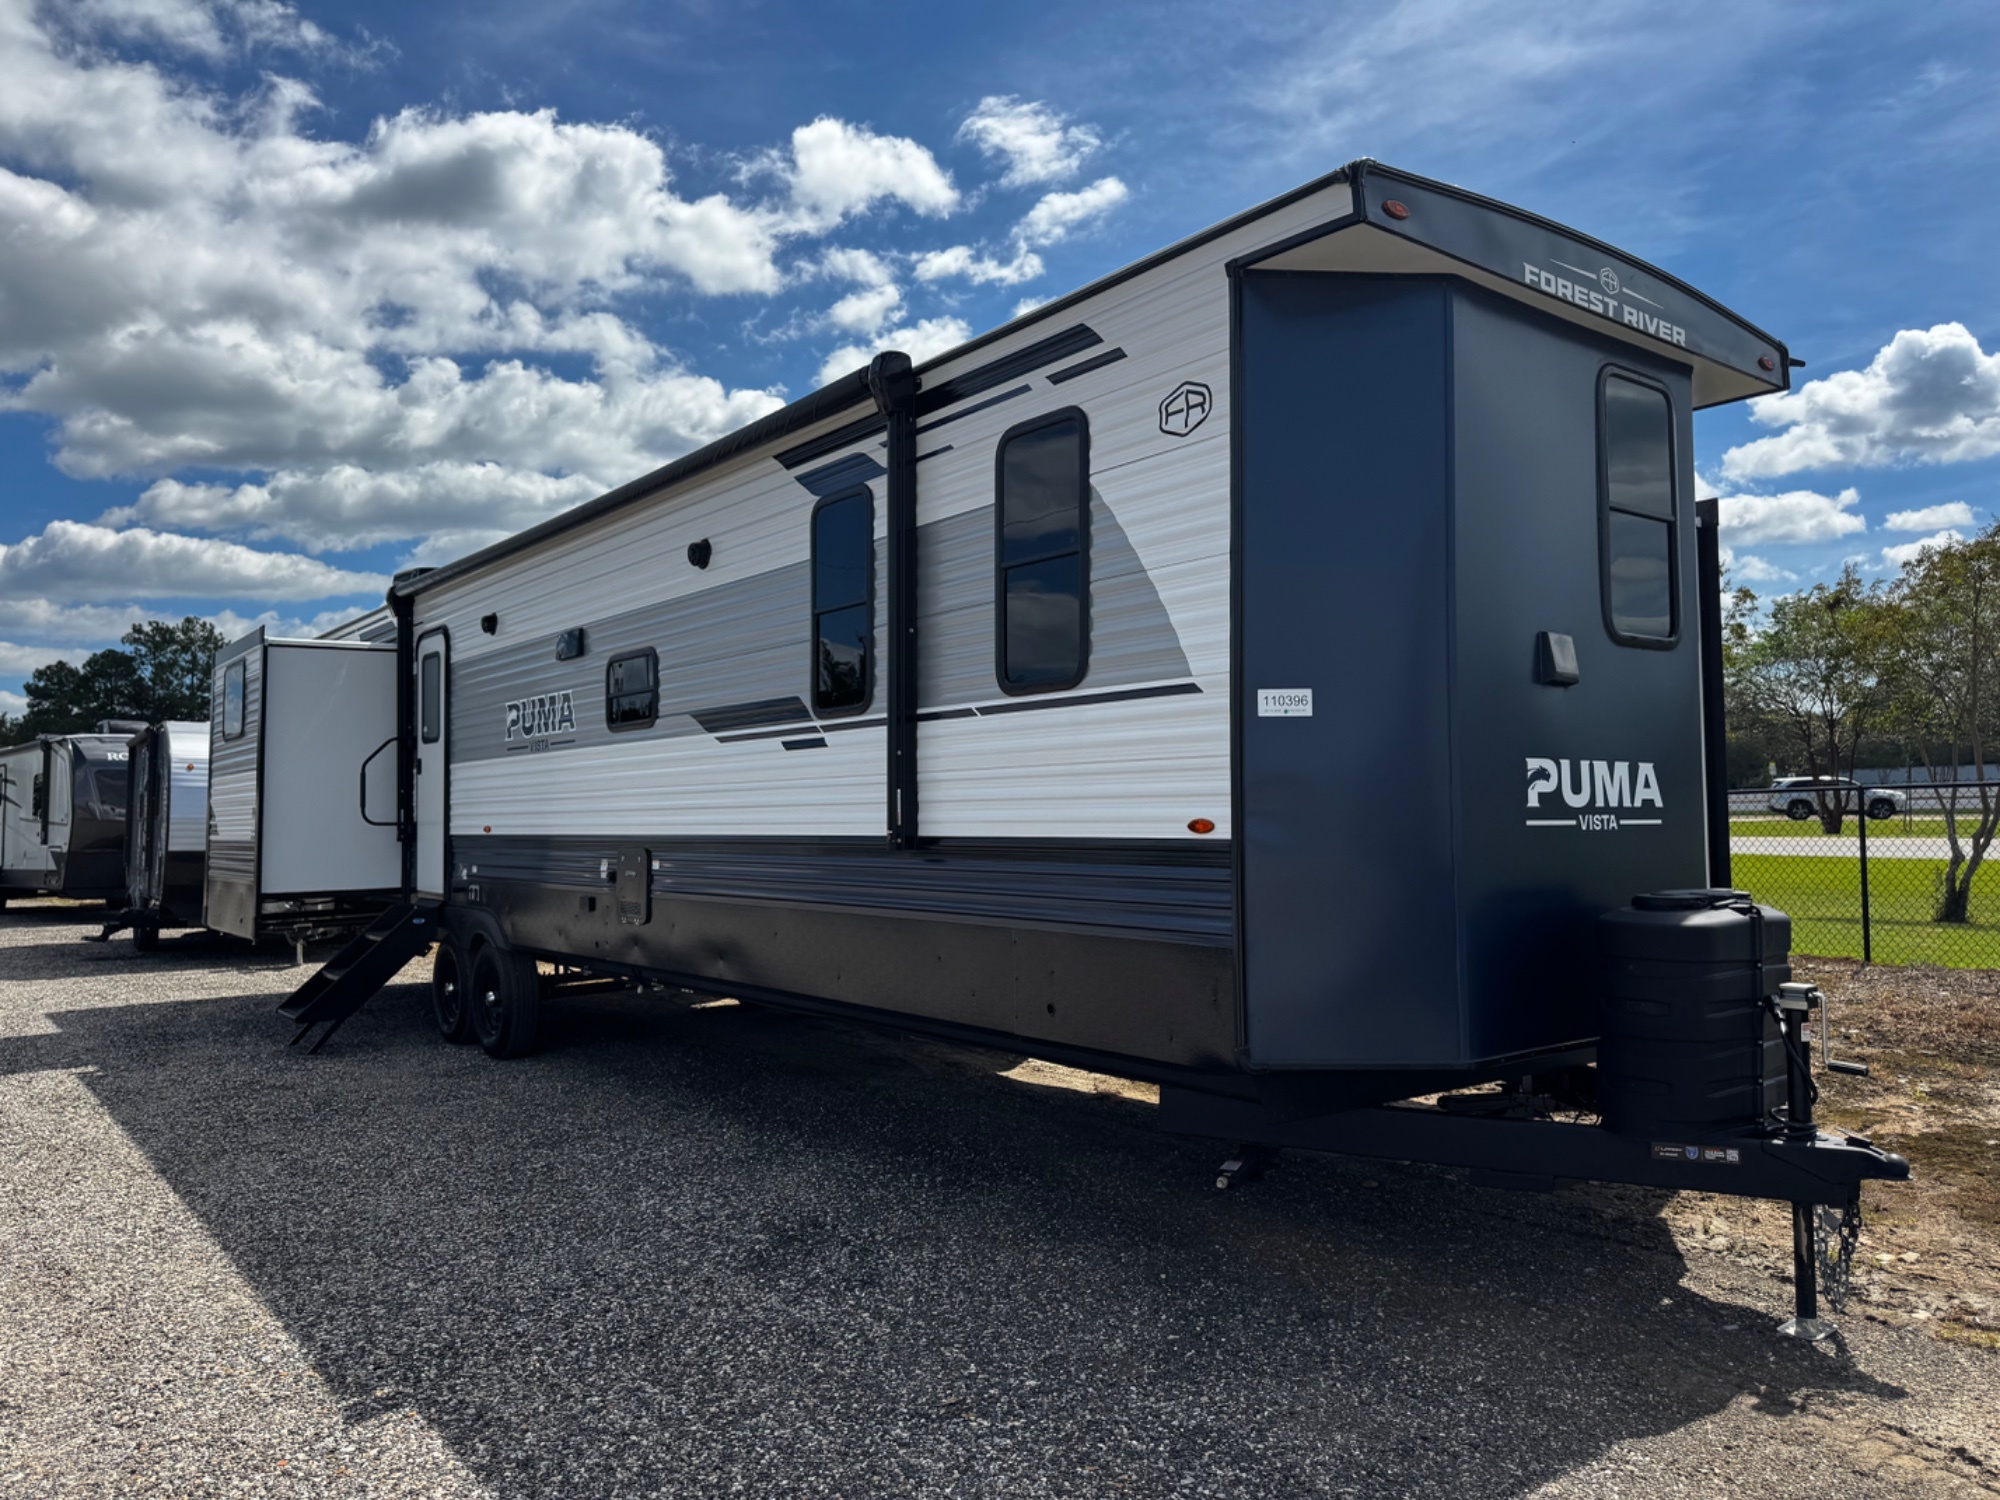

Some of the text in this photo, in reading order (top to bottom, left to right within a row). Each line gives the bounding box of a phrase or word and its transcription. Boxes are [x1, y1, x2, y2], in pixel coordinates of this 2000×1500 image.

[1523, 262, 1686, 347] FOREST RIVER
[505, 690, 576, 741] PUMA
[1263, 695, 1309, 706] 110396
[529, 739, 550, 752] VISTA
[1525, 757, 1664, 808] PUMA
[1579, 814, 1618, 830] VISTA
